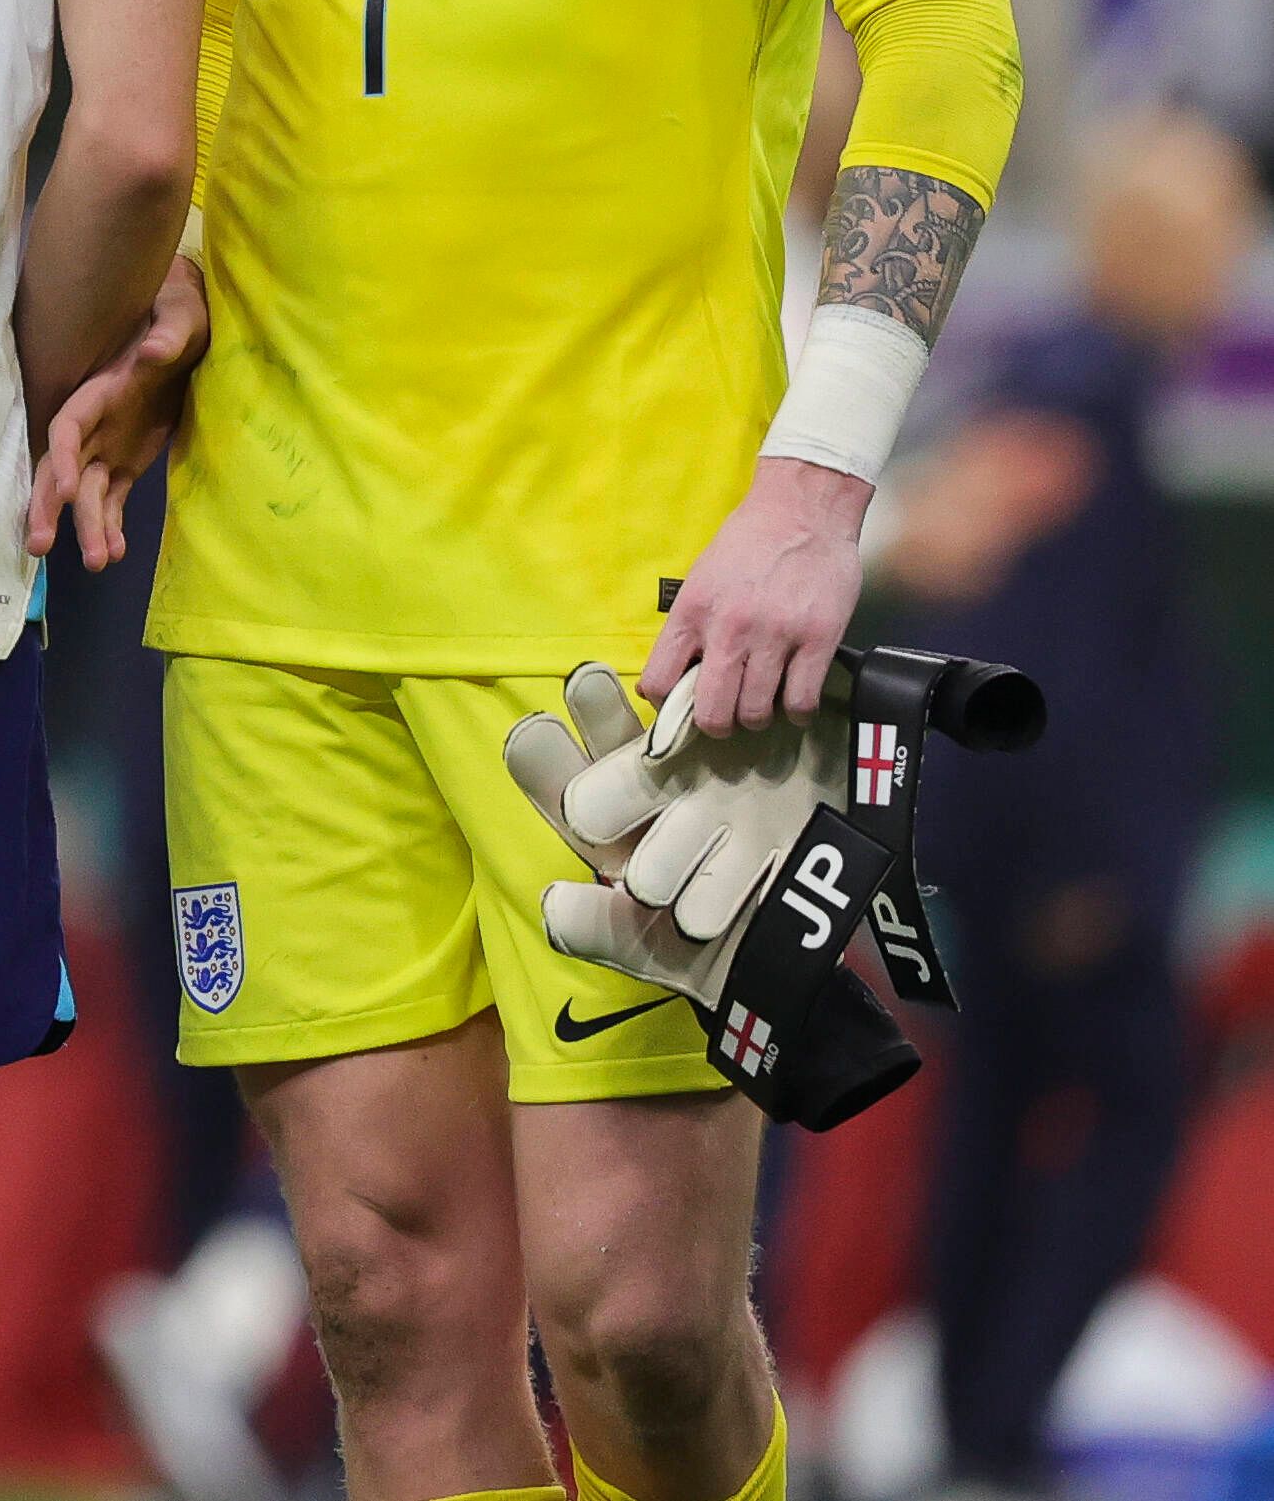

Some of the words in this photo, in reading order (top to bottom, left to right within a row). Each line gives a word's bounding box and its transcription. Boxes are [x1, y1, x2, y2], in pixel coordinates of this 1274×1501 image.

[893, 745, 908, 788] ARLO
[781, 842, 851, 951] JP
[871, 891, 931, 984] JP
